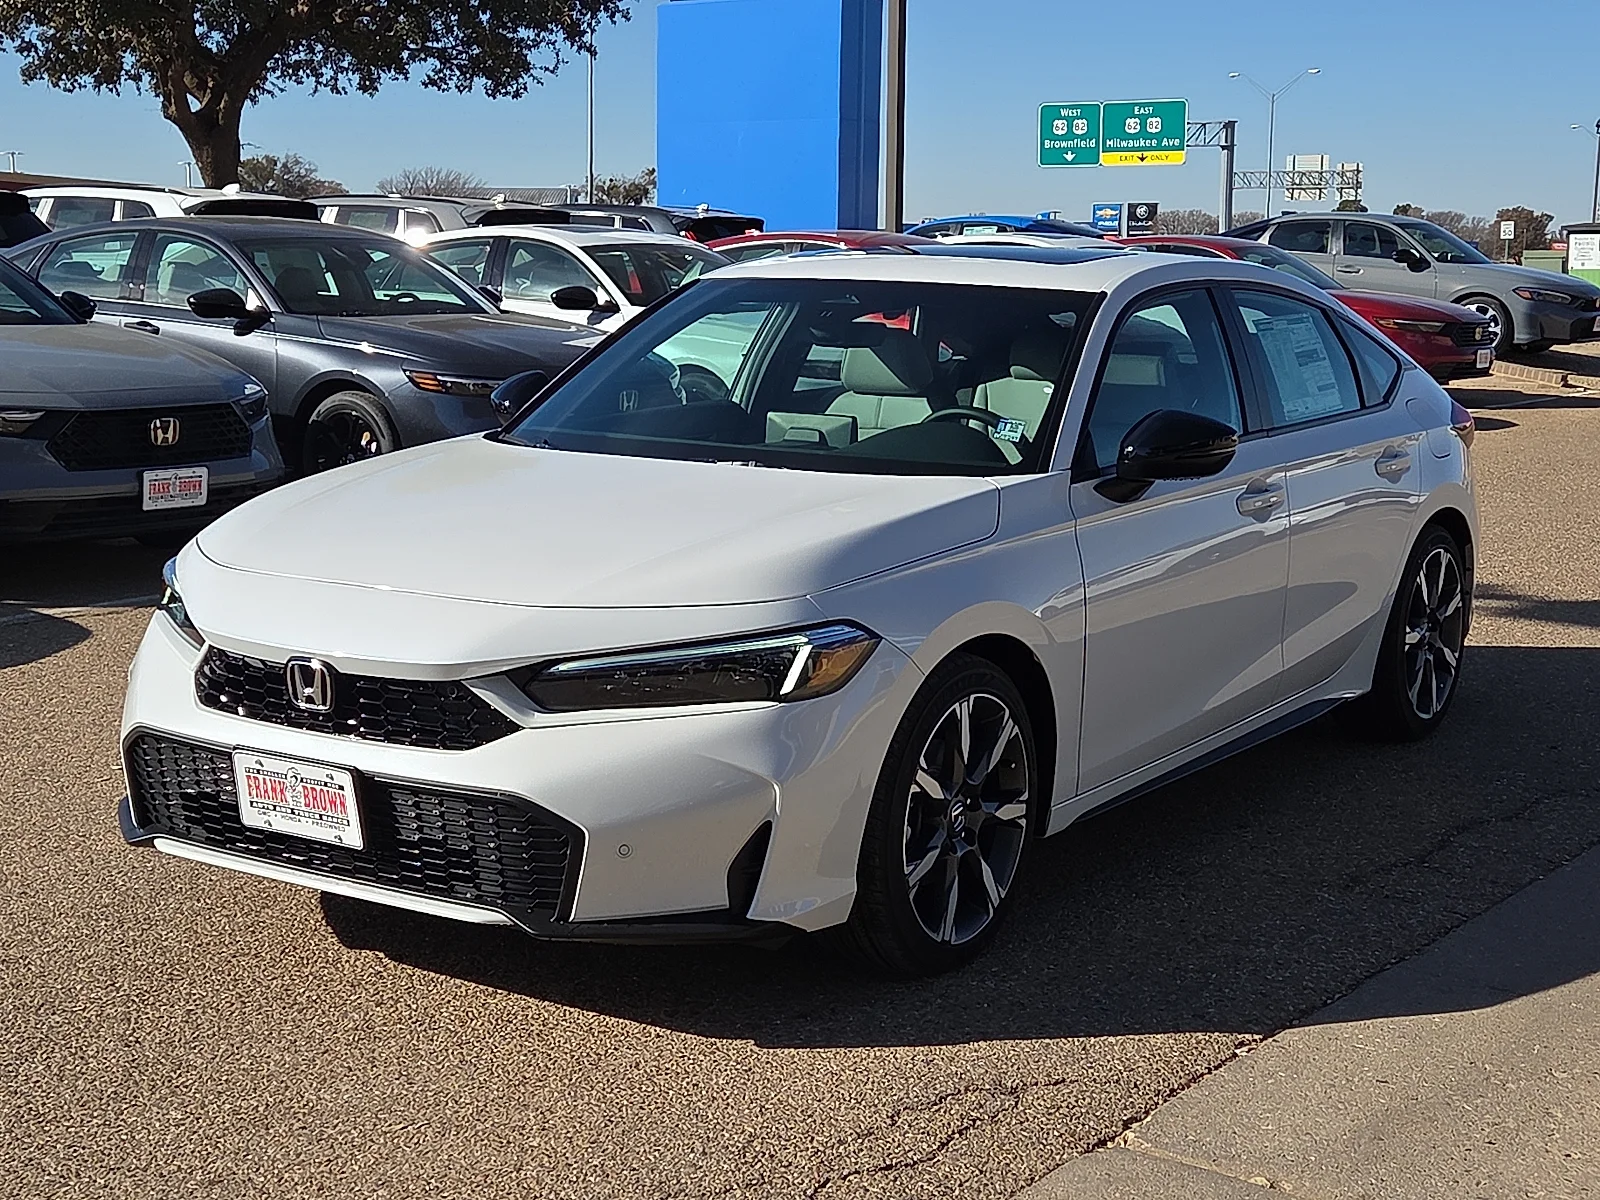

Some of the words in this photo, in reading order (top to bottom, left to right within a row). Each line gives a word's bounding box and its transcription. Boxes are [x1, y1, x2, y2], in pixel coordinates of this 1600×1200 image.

[1060, 108, 1081, 117] WEST
[1134, 106, 1153, 115] EAST
[1054, 122, 1066, 131] 62
[1074, 122, 1086, 131] 82
[1126, 121, 1139, 130] 62
[1148, 120, 1160, 130] 82
[1044, 138, 1096, 149] Brownfield
[1106, 137, 1158, 148] Milwaukee
[1161, 137, 1181, 147] Ave
[1502, 229, 1513, 237] 50
[245, 774, 289, 805] FRANK
[301, 784, 349, 818] BROWN
[251, 801, 274, 810] AUTO
[275, 805, 292, 814] AND
[293, 809, 321, 820] TRUCK
[321, 815, 348, 826] RANCH
[256, 809, 272, 818] GMC
[280, 814, 302, 823] HONDA
